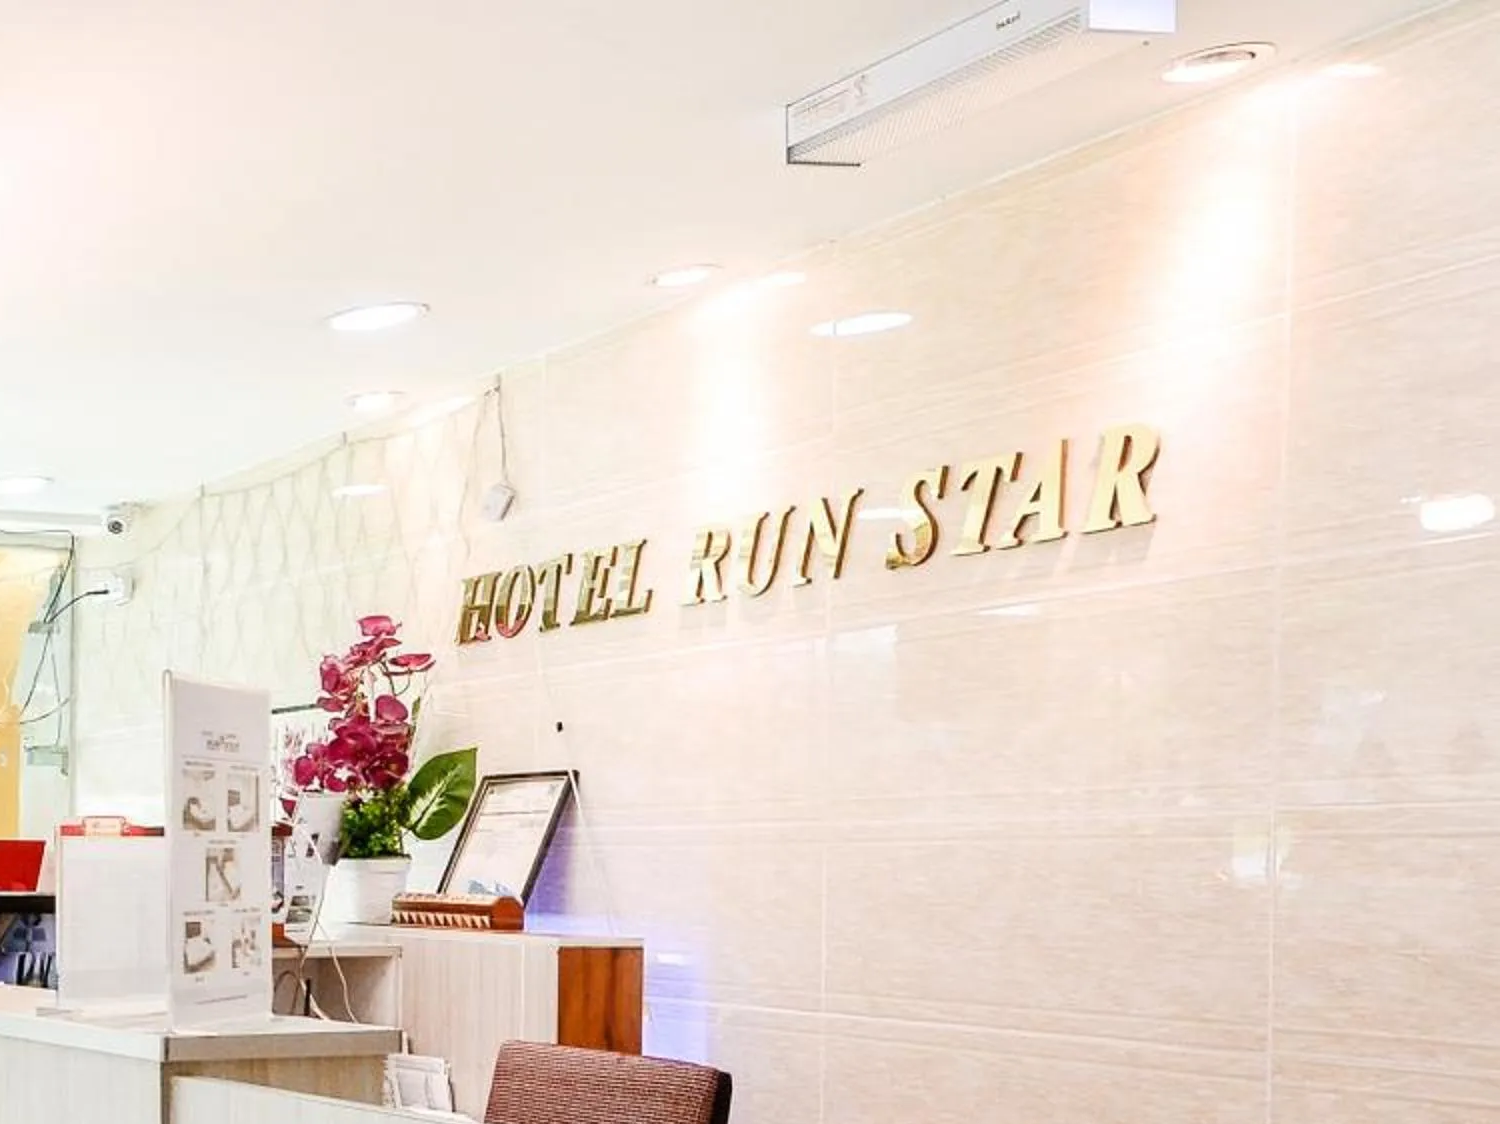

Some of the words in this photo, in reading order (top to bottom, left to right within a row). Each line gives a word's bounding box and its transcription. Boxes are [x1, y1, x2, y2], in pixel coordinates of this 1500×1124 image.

[455, 537, 653, 645] HOTEL
[681, 488, 864, 606] RUN
[885, 422, 1162, 571] STAR
